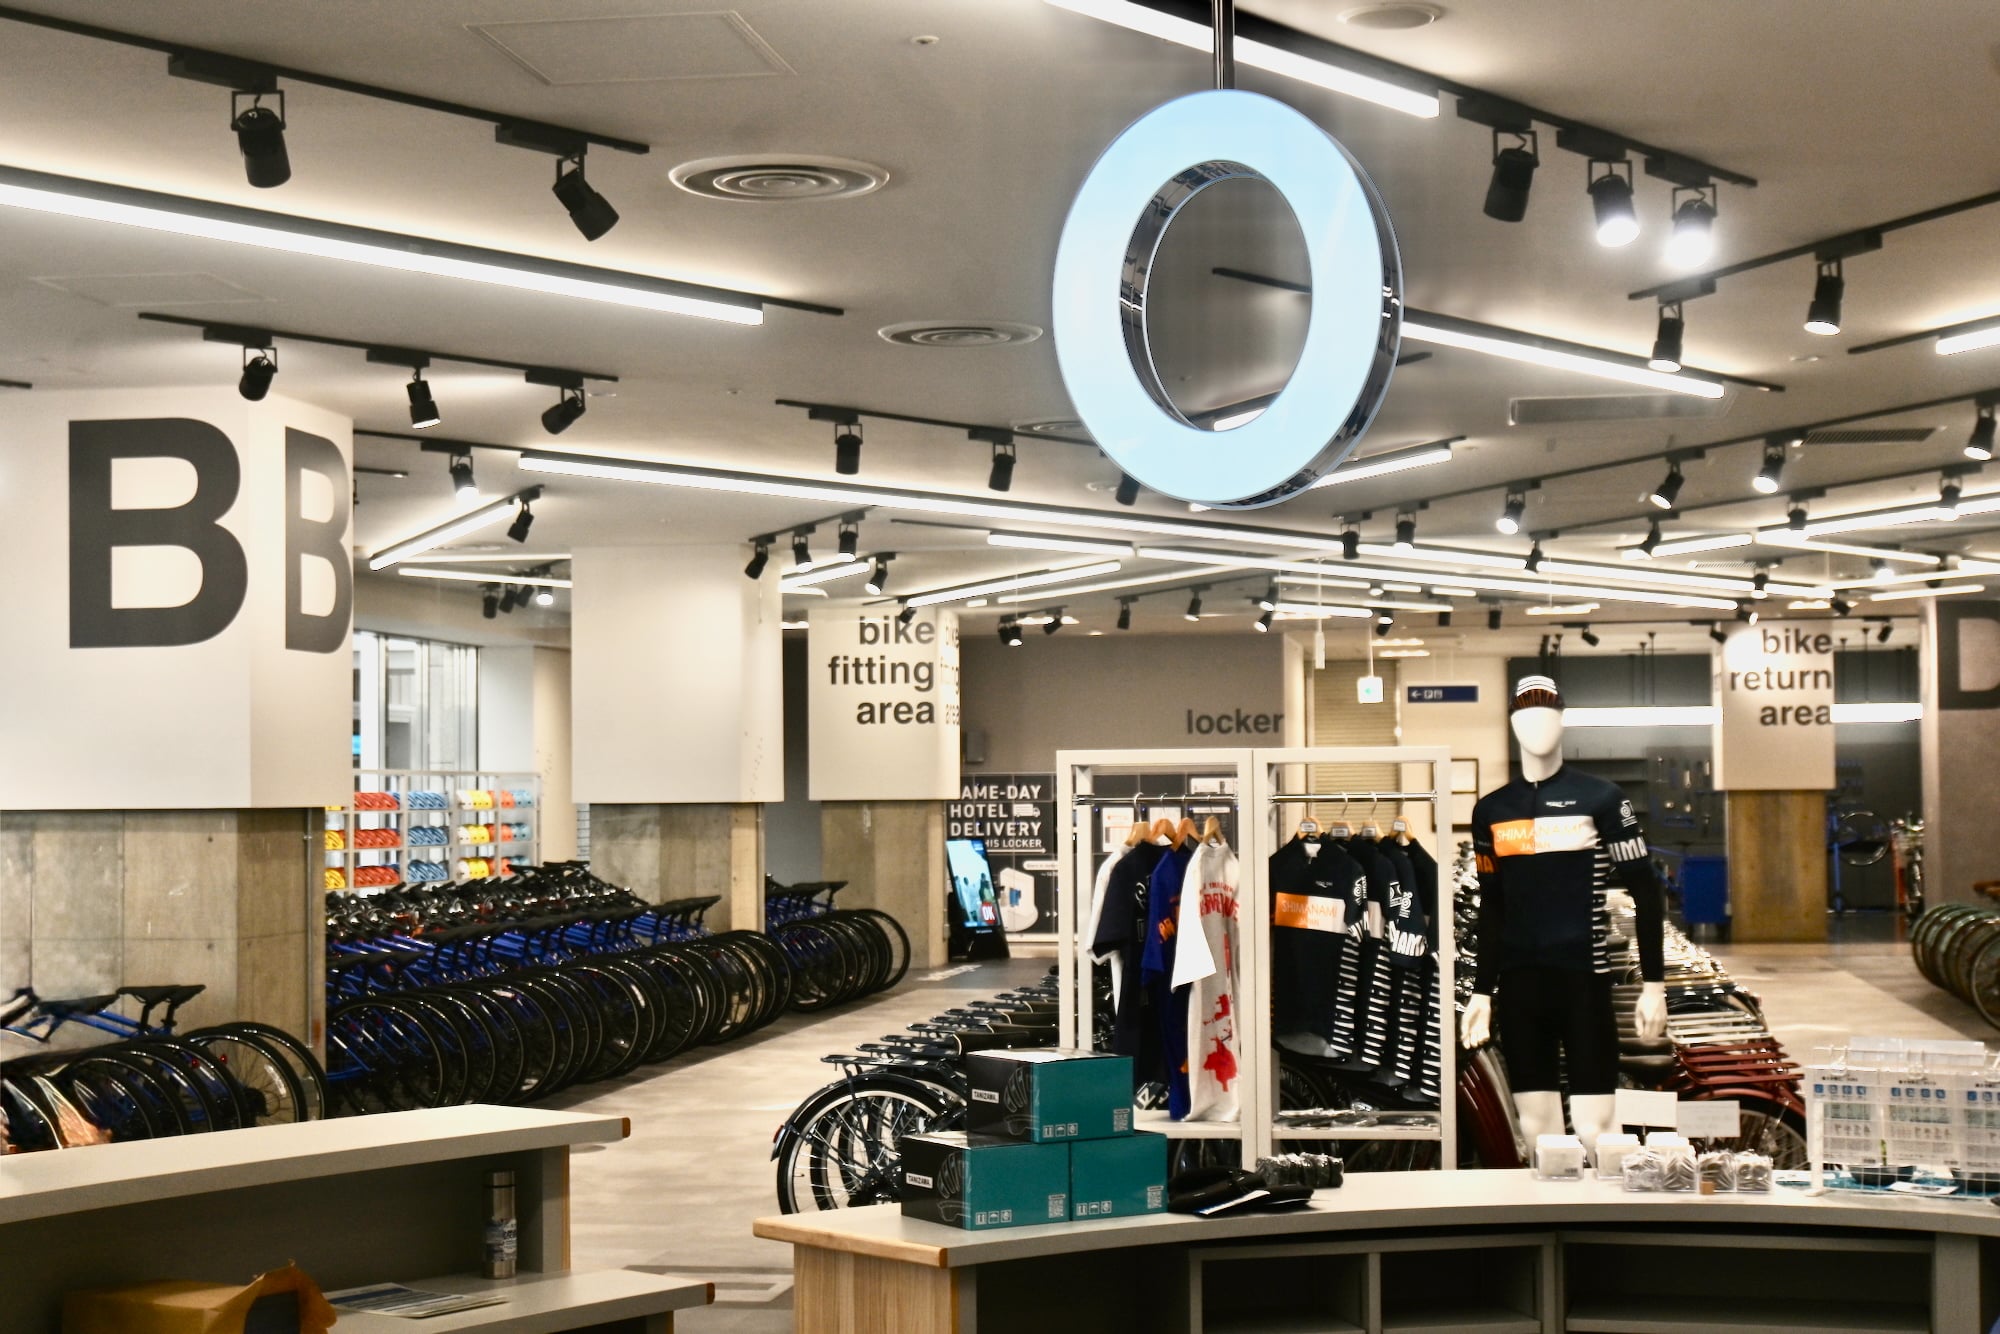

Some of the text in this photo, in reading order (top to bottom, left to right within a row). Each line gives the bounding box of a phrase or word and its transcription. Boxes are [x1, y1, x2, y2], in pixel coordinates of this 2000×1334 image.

[68, 417, 248, 649] B
[285, 425, 353, 655] B
[859, 615, 935, 645] bike
[1762, 627, 1832, 654] bike
[828, 655, 934, 692] fitting
[1730, 667, 1833, 691] return
[857, 701, 935, 725] area
[1187, 708, 1284, 734] locker
[1760, 704, 1832, 726] area
[962, 785, 1041, 800] AME-DAY
[950, 804, 1008, 818] HOTEL
[951, 822, 1041, 837] DELIVERY
[985, 840, 1042, 848] HIS LOCKER
